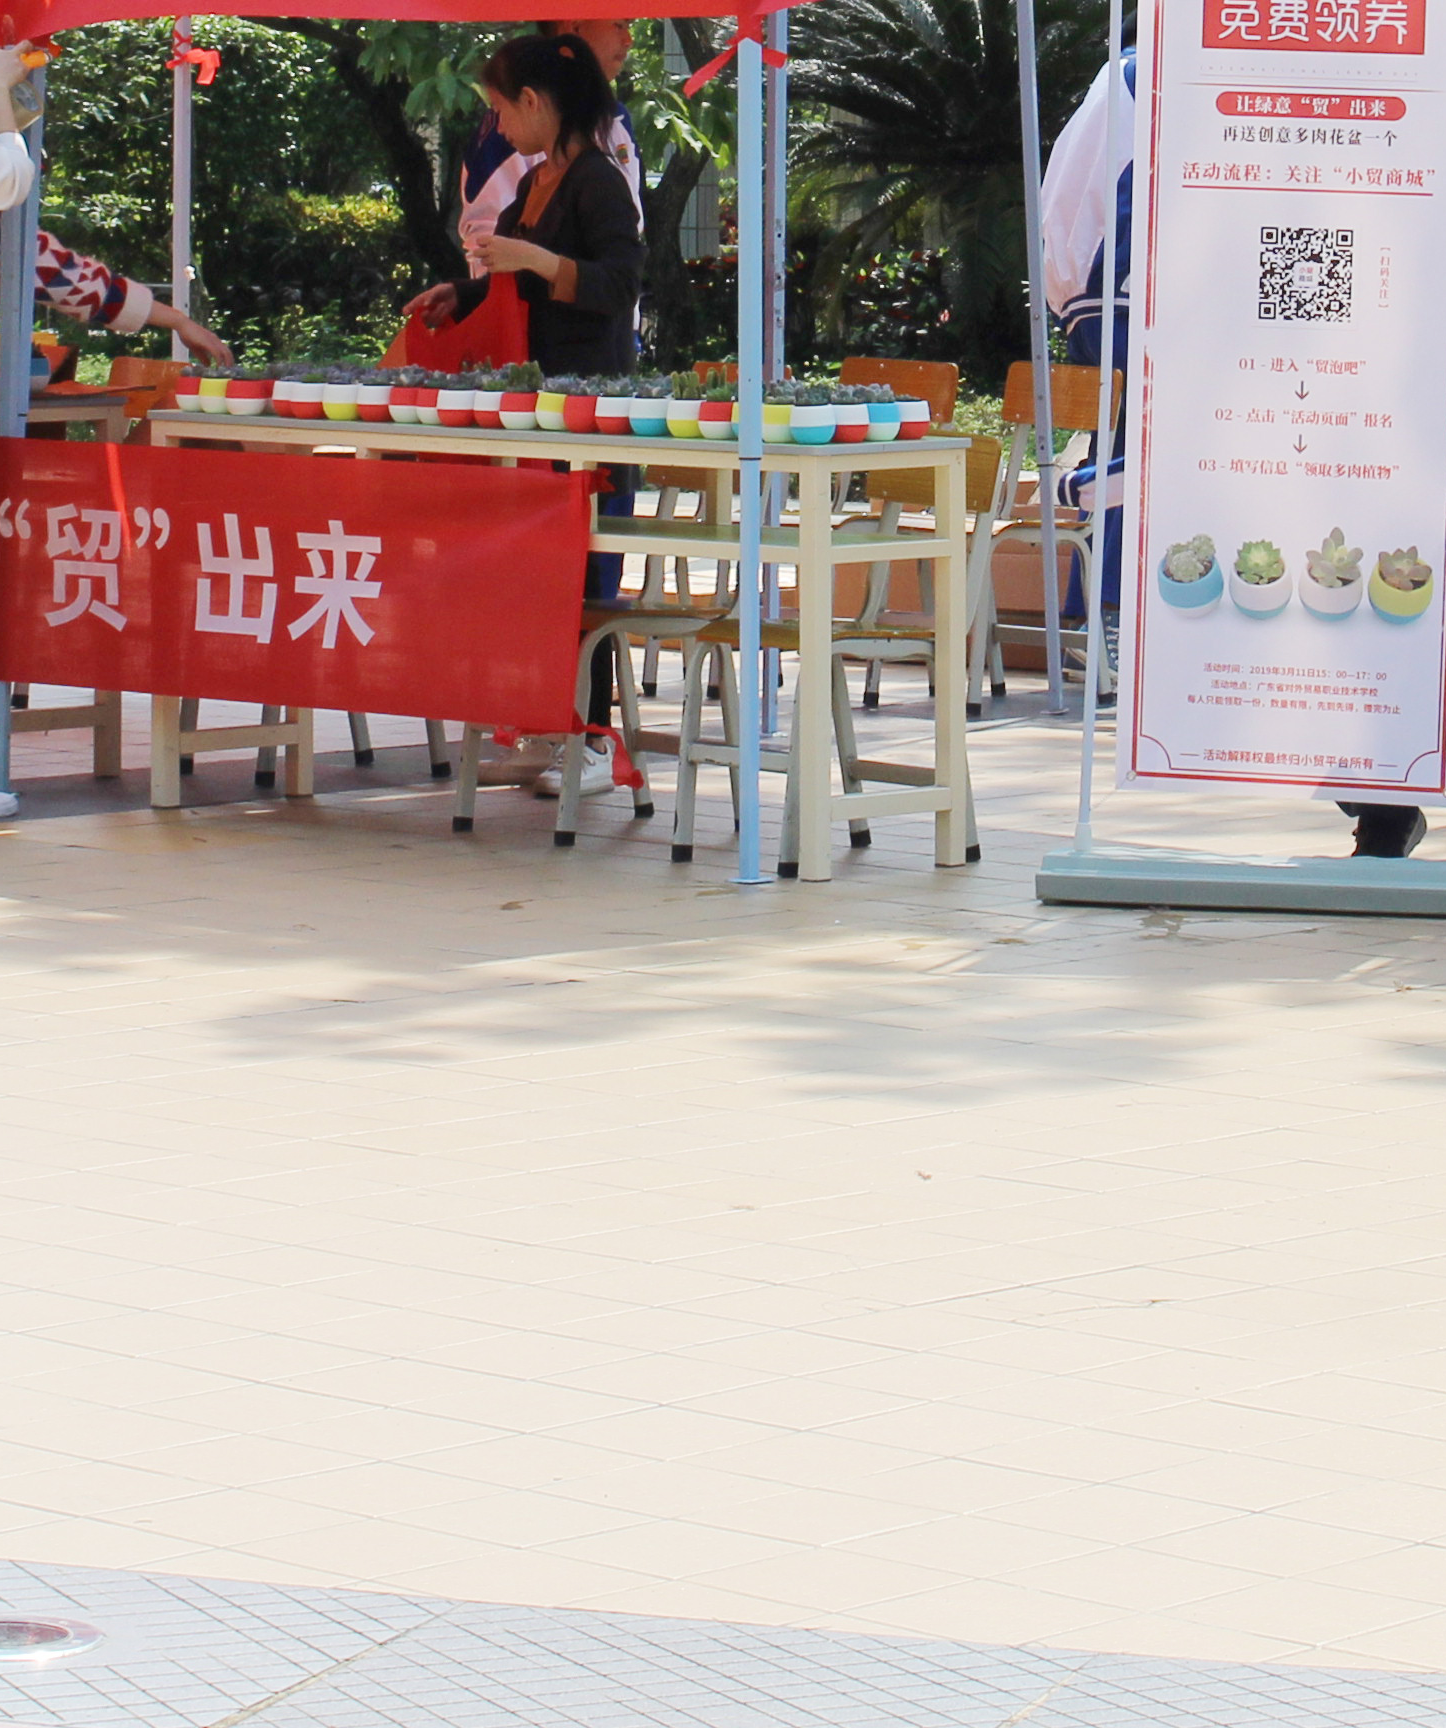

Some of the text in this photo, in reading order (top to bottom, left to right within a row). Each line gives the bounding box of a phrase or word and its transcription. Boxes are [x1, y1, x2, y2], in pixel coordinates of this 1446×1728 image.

[1222, 126, 1398, 148] 再送创意多肉花盆一个
